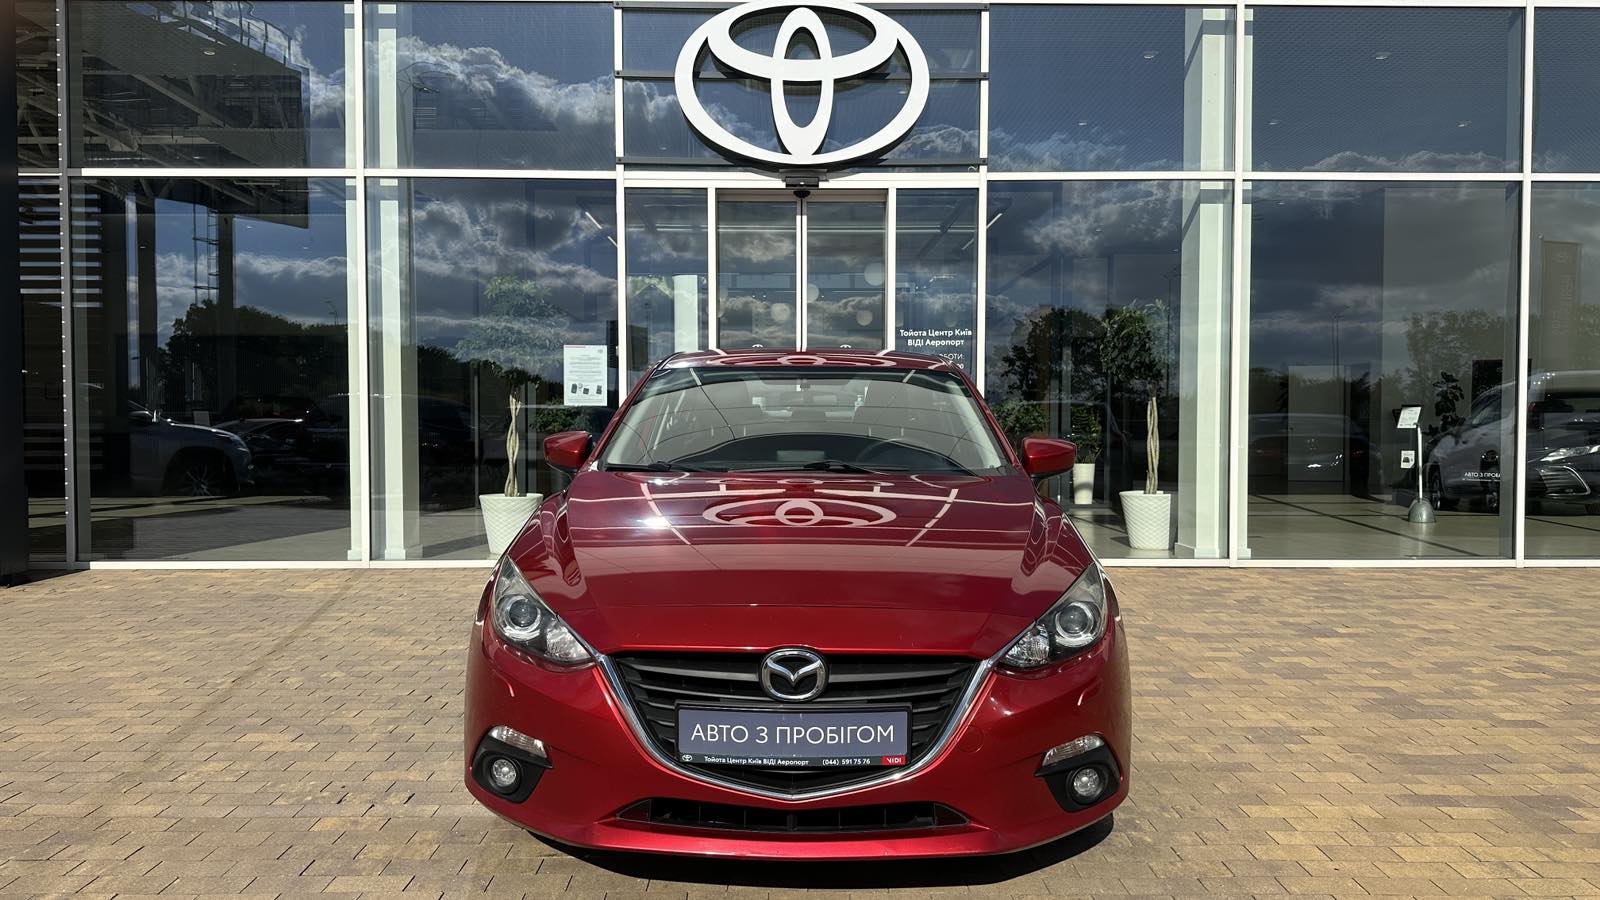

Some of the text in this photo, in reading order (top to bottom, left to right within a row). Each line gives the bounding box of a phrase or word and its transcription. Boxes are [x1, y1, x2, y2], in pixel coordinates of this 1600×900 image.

[900, 328, 973, 338] Тойота Центр Київ
[907, 339, 965, 347] ВІДІ Аеропорт
[690, 723, 894, 744] АВТО З ПРОБІГОМ
[727, 757, 747, 765] Центр
[822, 758, 839, 766] (044)
